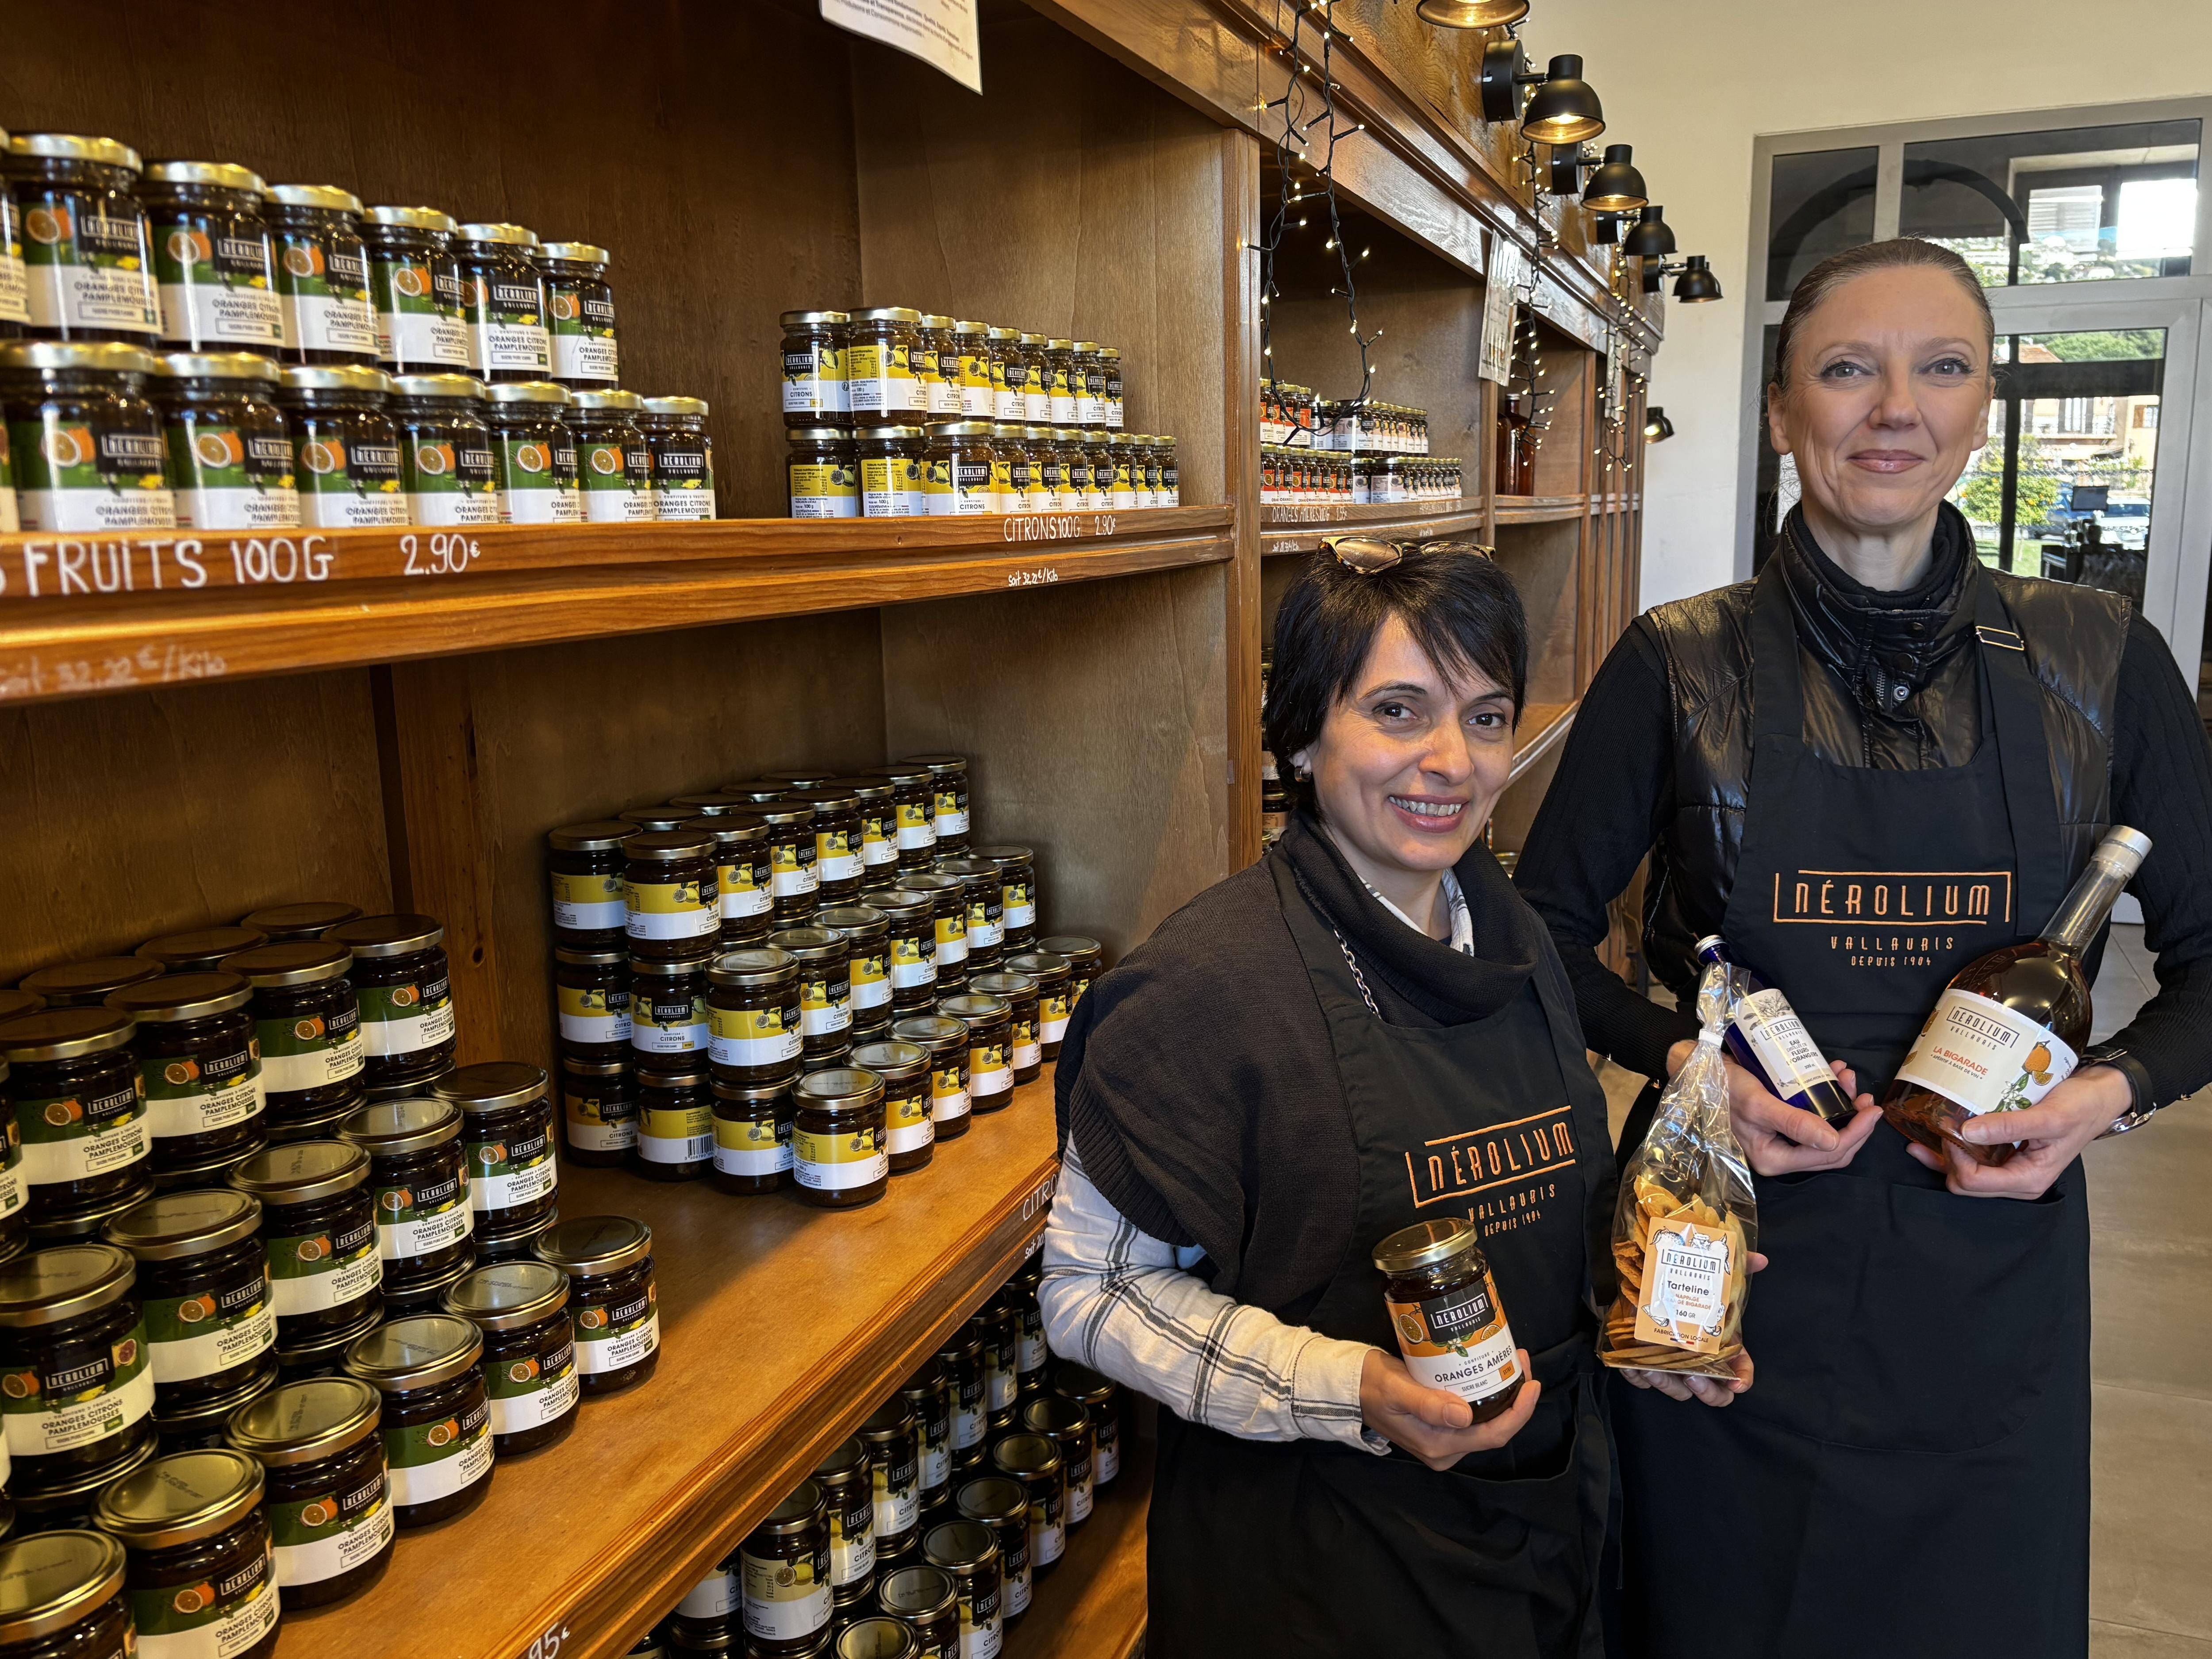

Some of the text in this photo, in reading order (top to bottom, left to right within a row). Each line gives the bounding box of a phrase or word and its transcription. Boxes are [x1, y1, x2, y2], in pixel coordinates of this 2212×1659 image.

[1795, 879, 1990, 916] NÉROLIUM
[1831, 936, 1954, 951] VALLAURIS
[1851, 956, 1932, 967] DEPUIS 1904
[1952, 1010, 2012, 1043] NÉROLIUM
[1950, 1025, 1997, 1051] VALLAURIS
[1791, 1047, 1810, 1056] FLEURS
[1932, 1045, 1989, 1076] LA BIGARADE
[1952, 1063, 1964, 1071] BASE
[1428, 1121, 1575, 1191] NÉROLIUM
[507, 1166, 551, 1188] ORANGES CITRONS
[511, 1173, 550, 1192] PAMPLEMOUSSES
[1023, 1174, 1057, 1221] CITRO
[1468, 1183, 1555, 1222] VALLAURIS
[413, 1212, 465, 1235] ORANGES CITRONS
[418, 1219, 464, 1240] PAMPLEMOUSSES
[1484, 1217, 1517, 1237] DEPUIS
[331, 1269, 362, 1285] ORANGES
[1670, 1268, 1711, 1281] VALLAURIS
[1667, 1280, 1709, 1296] Tarteline
[1675, 1294, 1699, 1302] NAPPAGE
[1686, 1301, 1711, 1310] BIGARADE
[1436, 1298, 1485, 1325] NÉROLIUM
[607, 1327, 653, 1352] ORANGES CITRONS
[611, 1335, 652, 1356] PAMPLEMOUSSES
[1690, 1335, 1709, 1343] LOCALE
[1435, 1345, 1513, 1382] ORANGES AMÈRES
[1464, 1352, 1490, 1365] CONFITURE
[1461, 1379, 1488, 1392] SUCRE BLANC
[41, 1414, 84, 1430] ORANGES
[854, 1543, 874, 1562] CITRON
[983, 1630, 1000, 1647] CITRO
